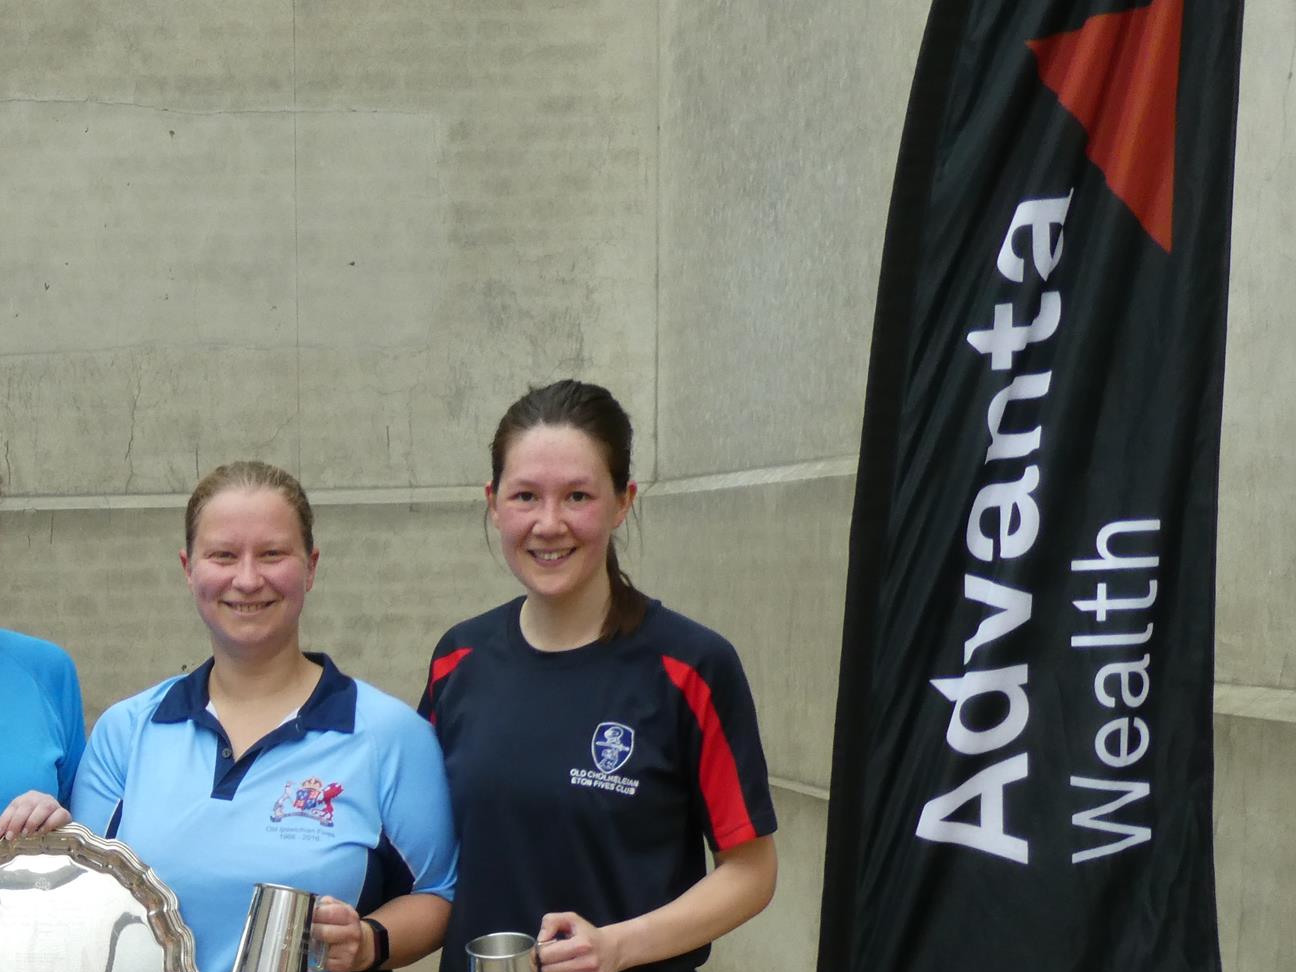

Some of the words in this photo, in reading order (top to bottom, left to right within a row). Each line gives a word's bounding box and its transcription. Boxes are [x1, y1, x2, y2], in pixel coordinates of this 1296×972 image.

[915, 187, 1074, 866] Advanta
[570, 768, 587, 778] OLD
[1070, 518, 1161, 865] Wealth
[570, 776, 593, 786] ETON
[593, 780, 615, 791] FIVES
[615, 785, 636, 795] CLUB
